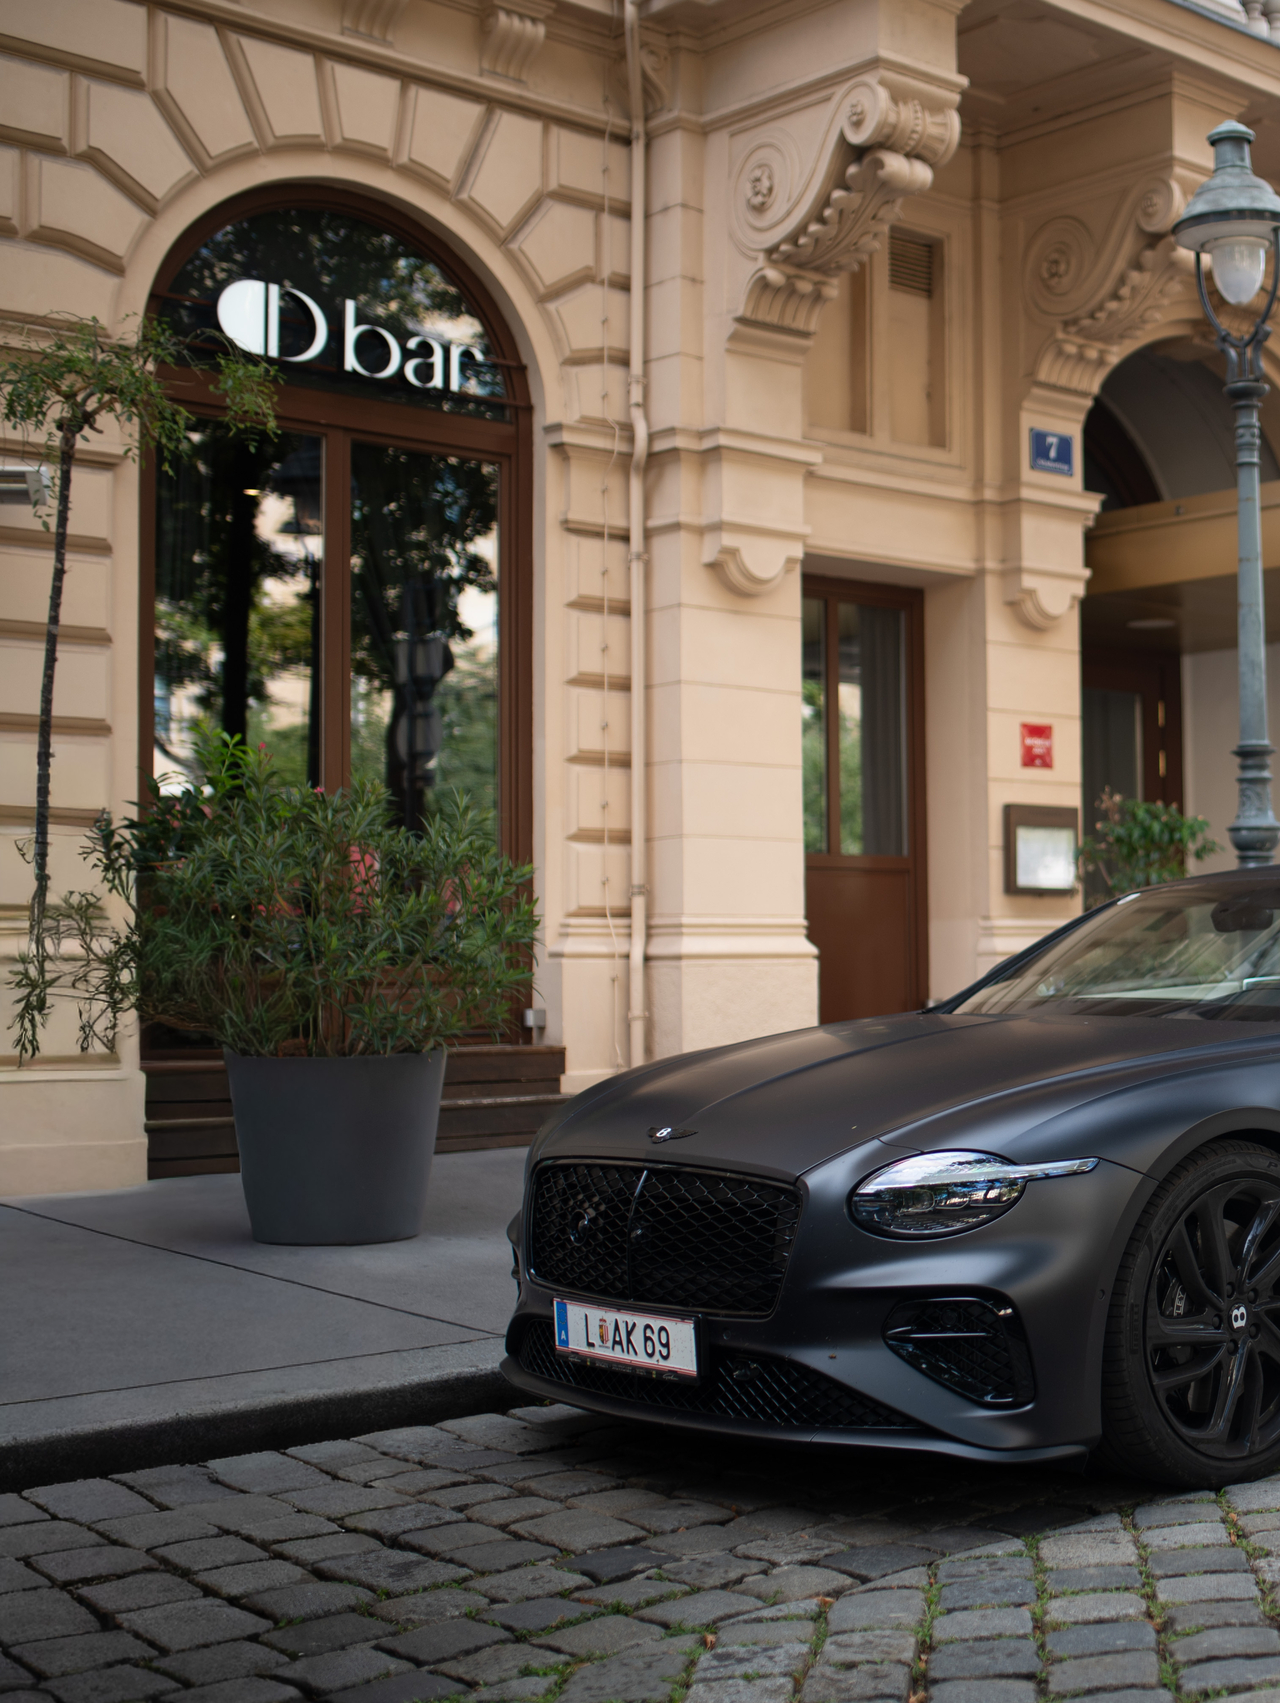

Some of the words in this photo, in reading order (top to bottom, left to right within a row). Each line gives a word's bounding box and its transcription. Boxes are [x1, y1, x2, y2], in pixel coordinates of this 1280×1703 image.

[266, 281, 329, 363] D
[343, 298, 486, 393] bar
[1046, 435, 1059, 460] 7
[1231, 1306, 1247, 1330] B
[560, 1330, 567, 1341] A
[584, 1312, 595, 1347] L
[612, 1318, 638, 1356] AK
[643, 1323, 671, 1360] 69
